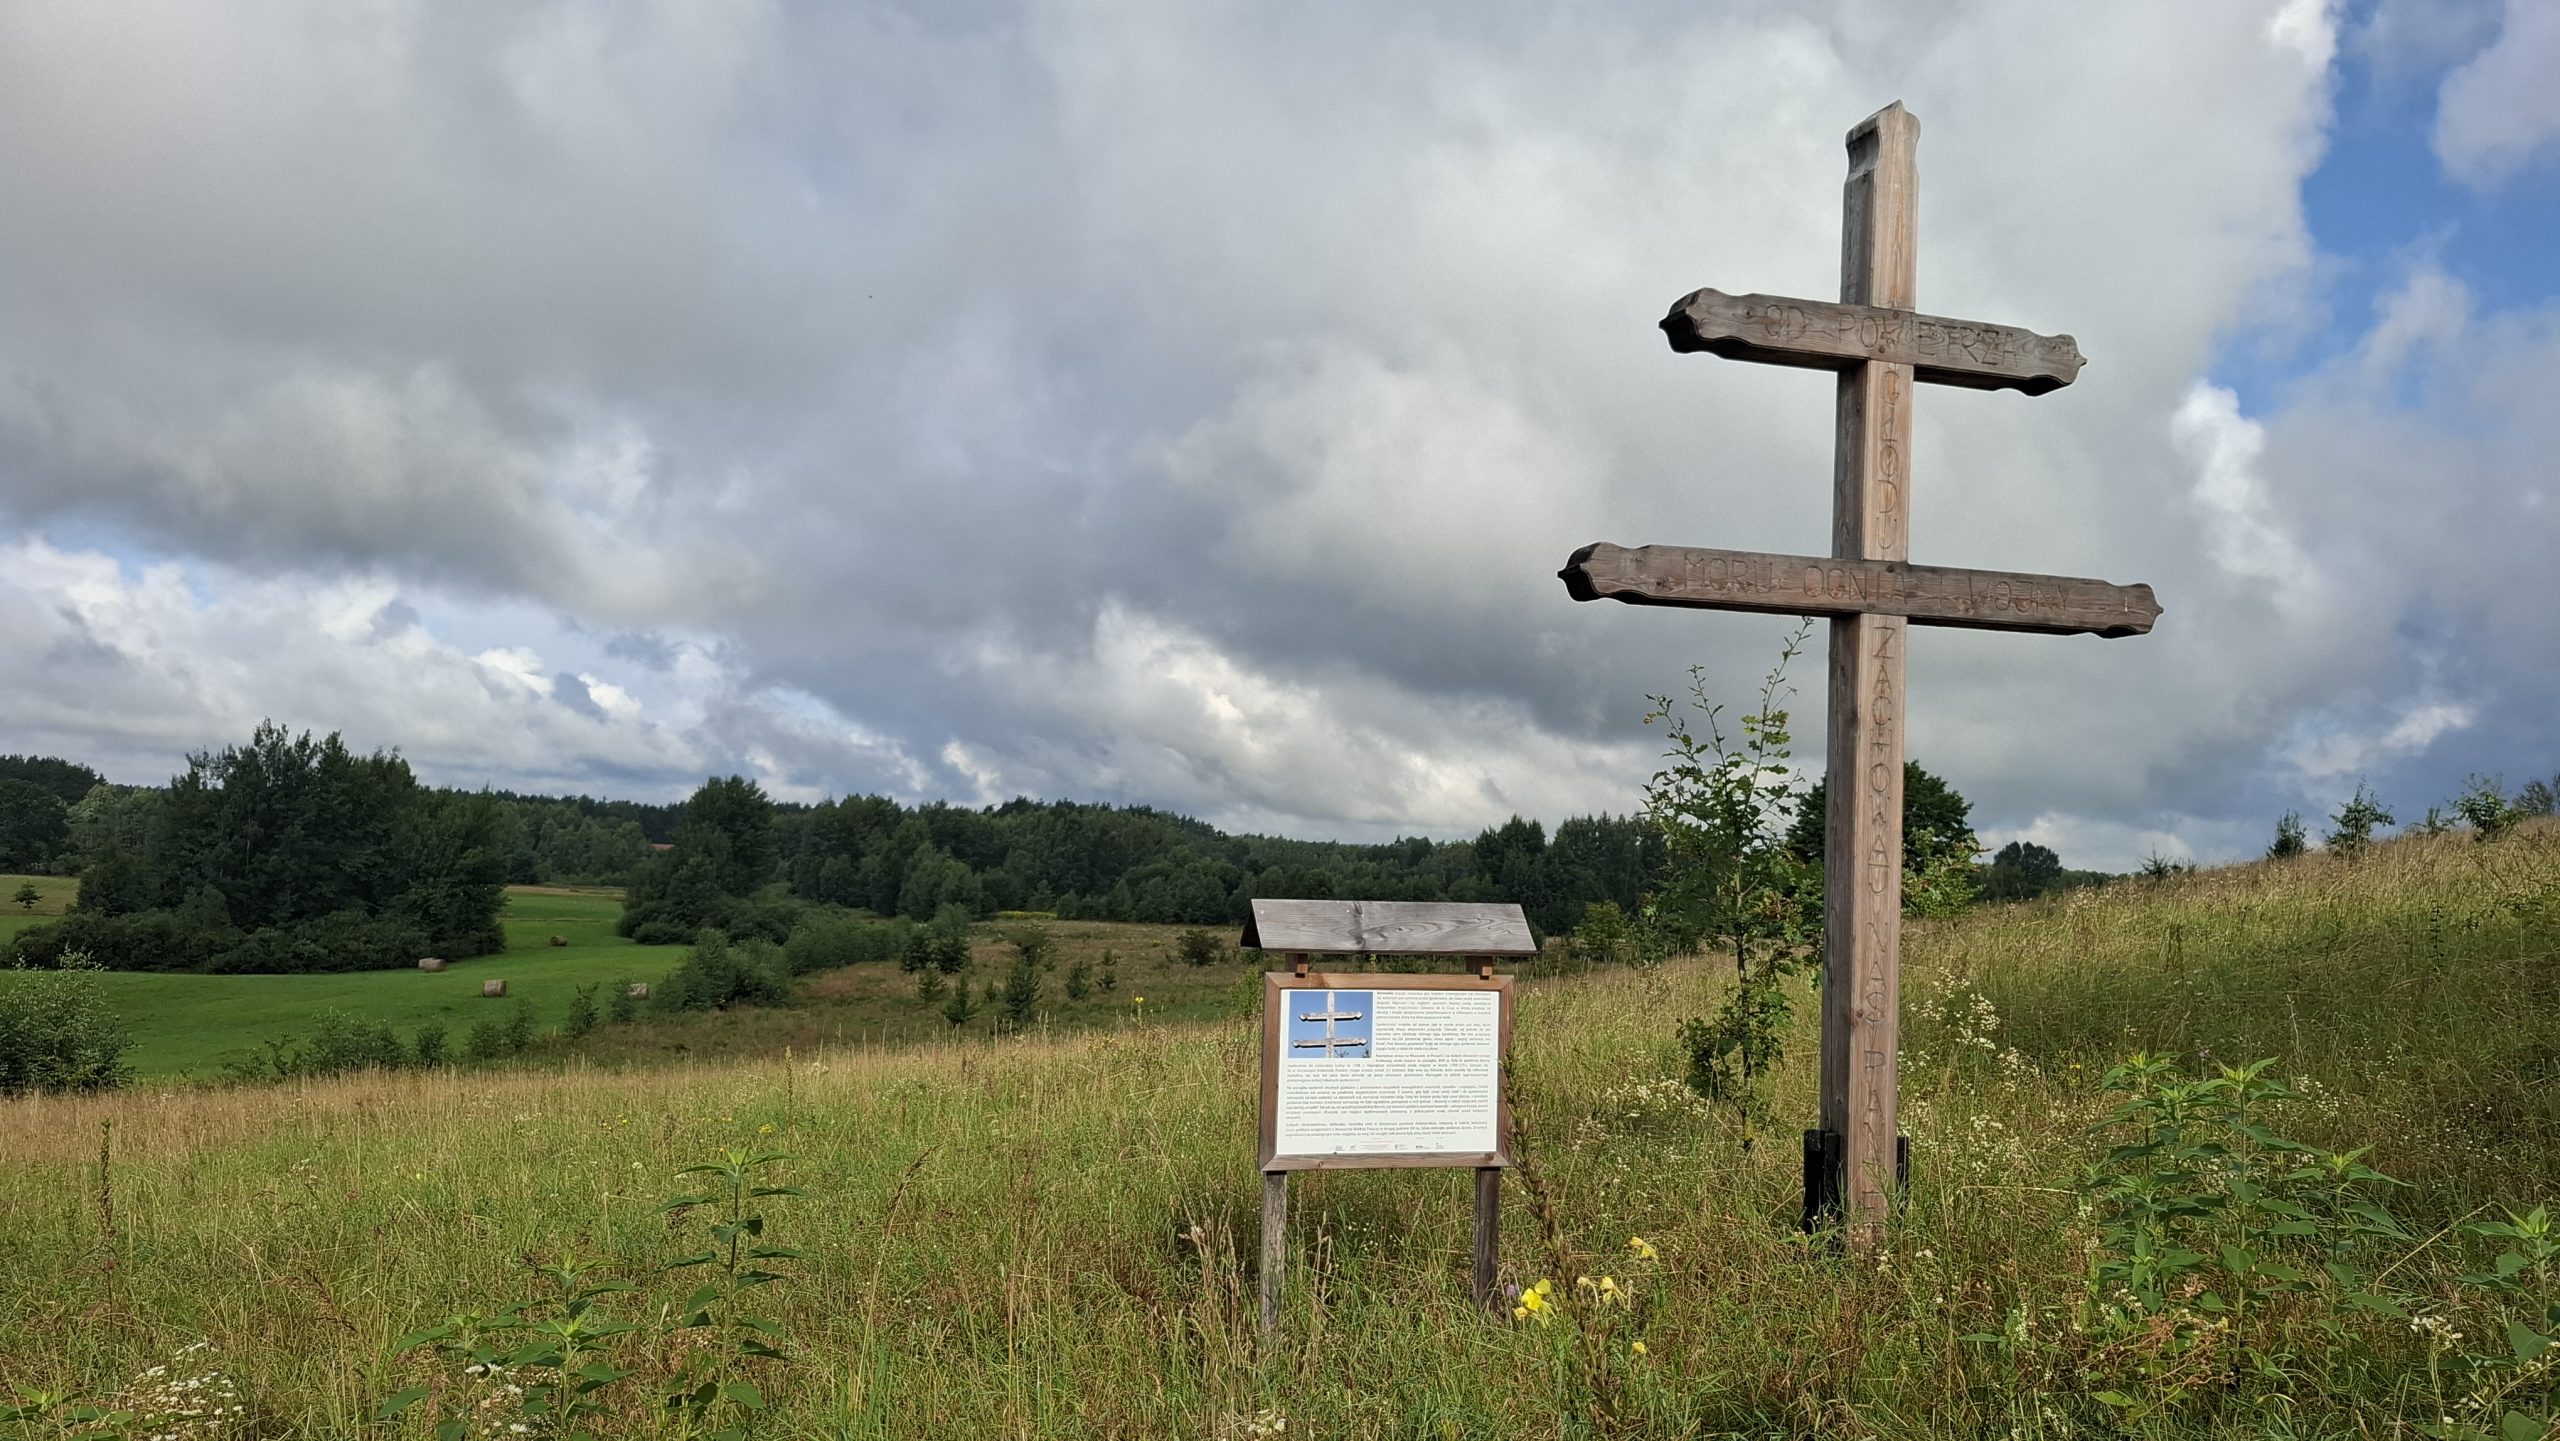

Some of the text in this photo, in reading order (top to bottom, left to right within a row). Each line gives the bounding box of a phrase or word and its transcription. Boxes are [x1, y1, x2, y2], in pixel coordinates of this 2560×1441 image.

[1764, 303, 1808, 341] OD
[1683, 553, 1773, 594] MORU
[1803, 565, 1909, 604] OGNIA
[1868, 625, 1896, 894] ZACHOWAJ
